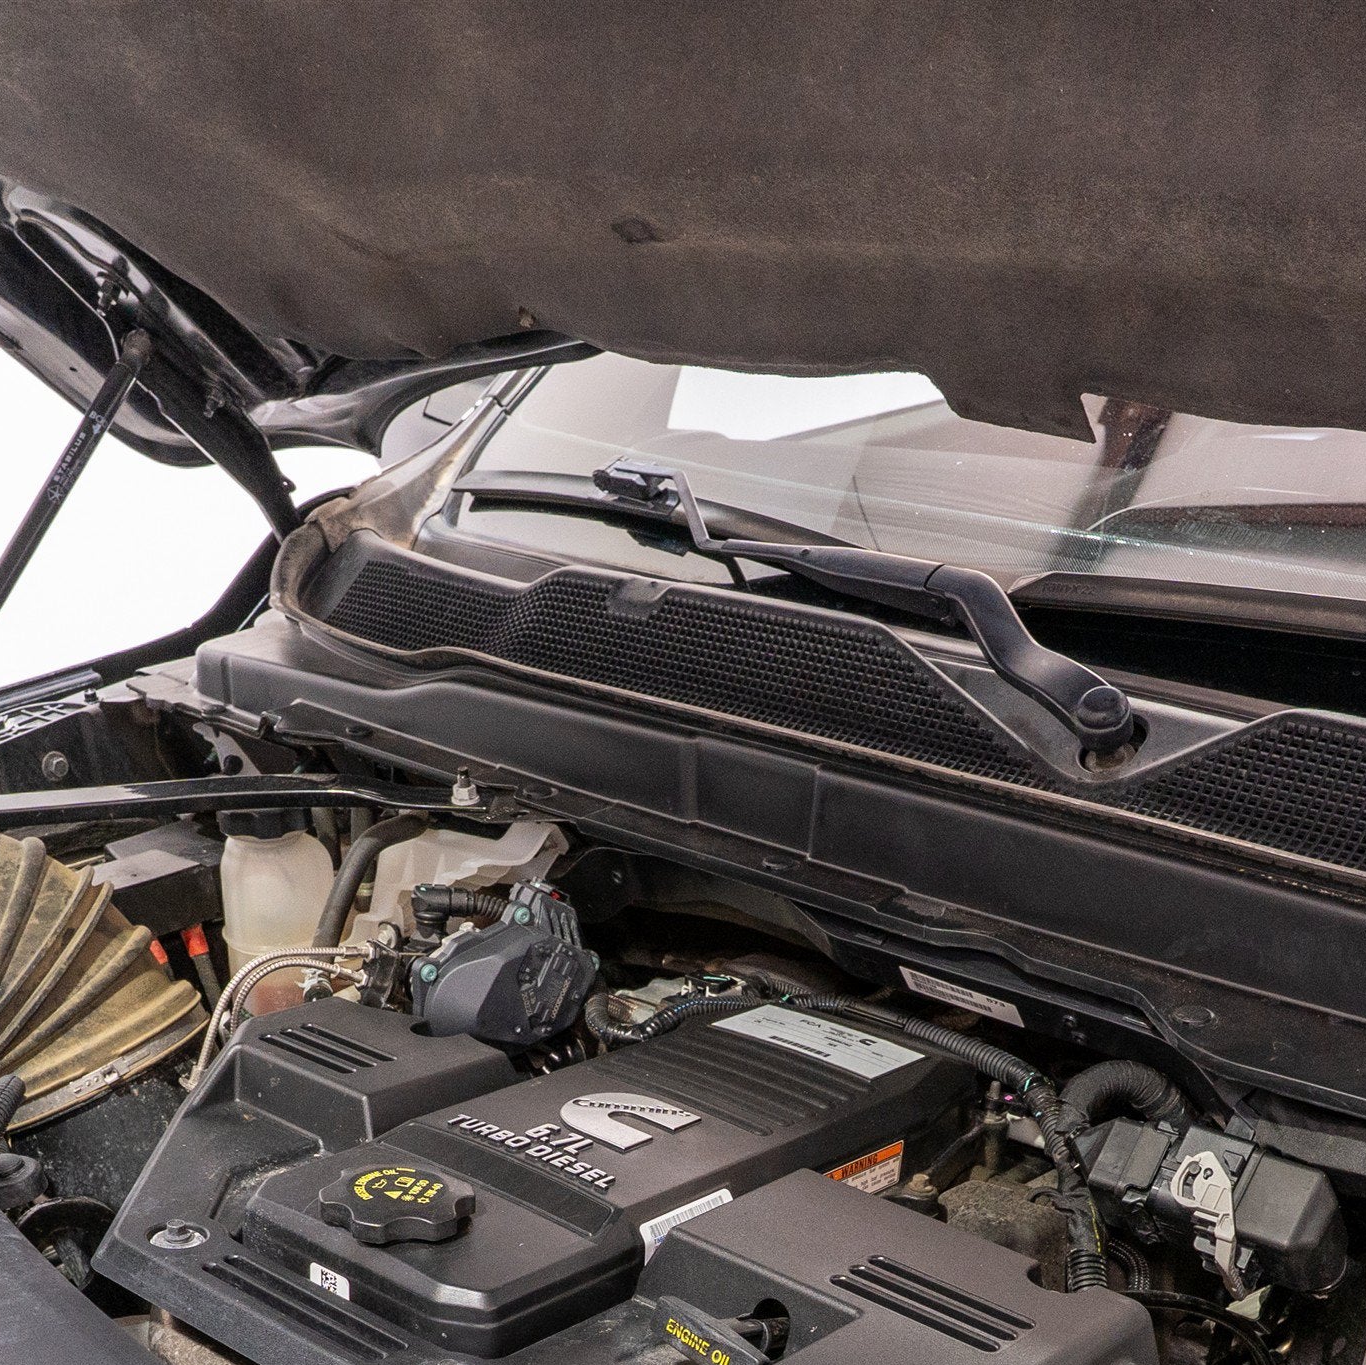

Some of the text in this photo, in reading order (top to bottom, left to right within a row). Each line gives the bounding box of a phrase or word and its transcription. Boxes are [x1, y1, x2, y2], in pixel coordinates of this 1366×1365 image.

[447, 1113, 616, 1194] TURBO DIESEL
[525, 1122, 594, 1158] 6.7L
[842, 1152, 878, 1178] WARNING
[666, 1318, 710, 1356] ENGINE
